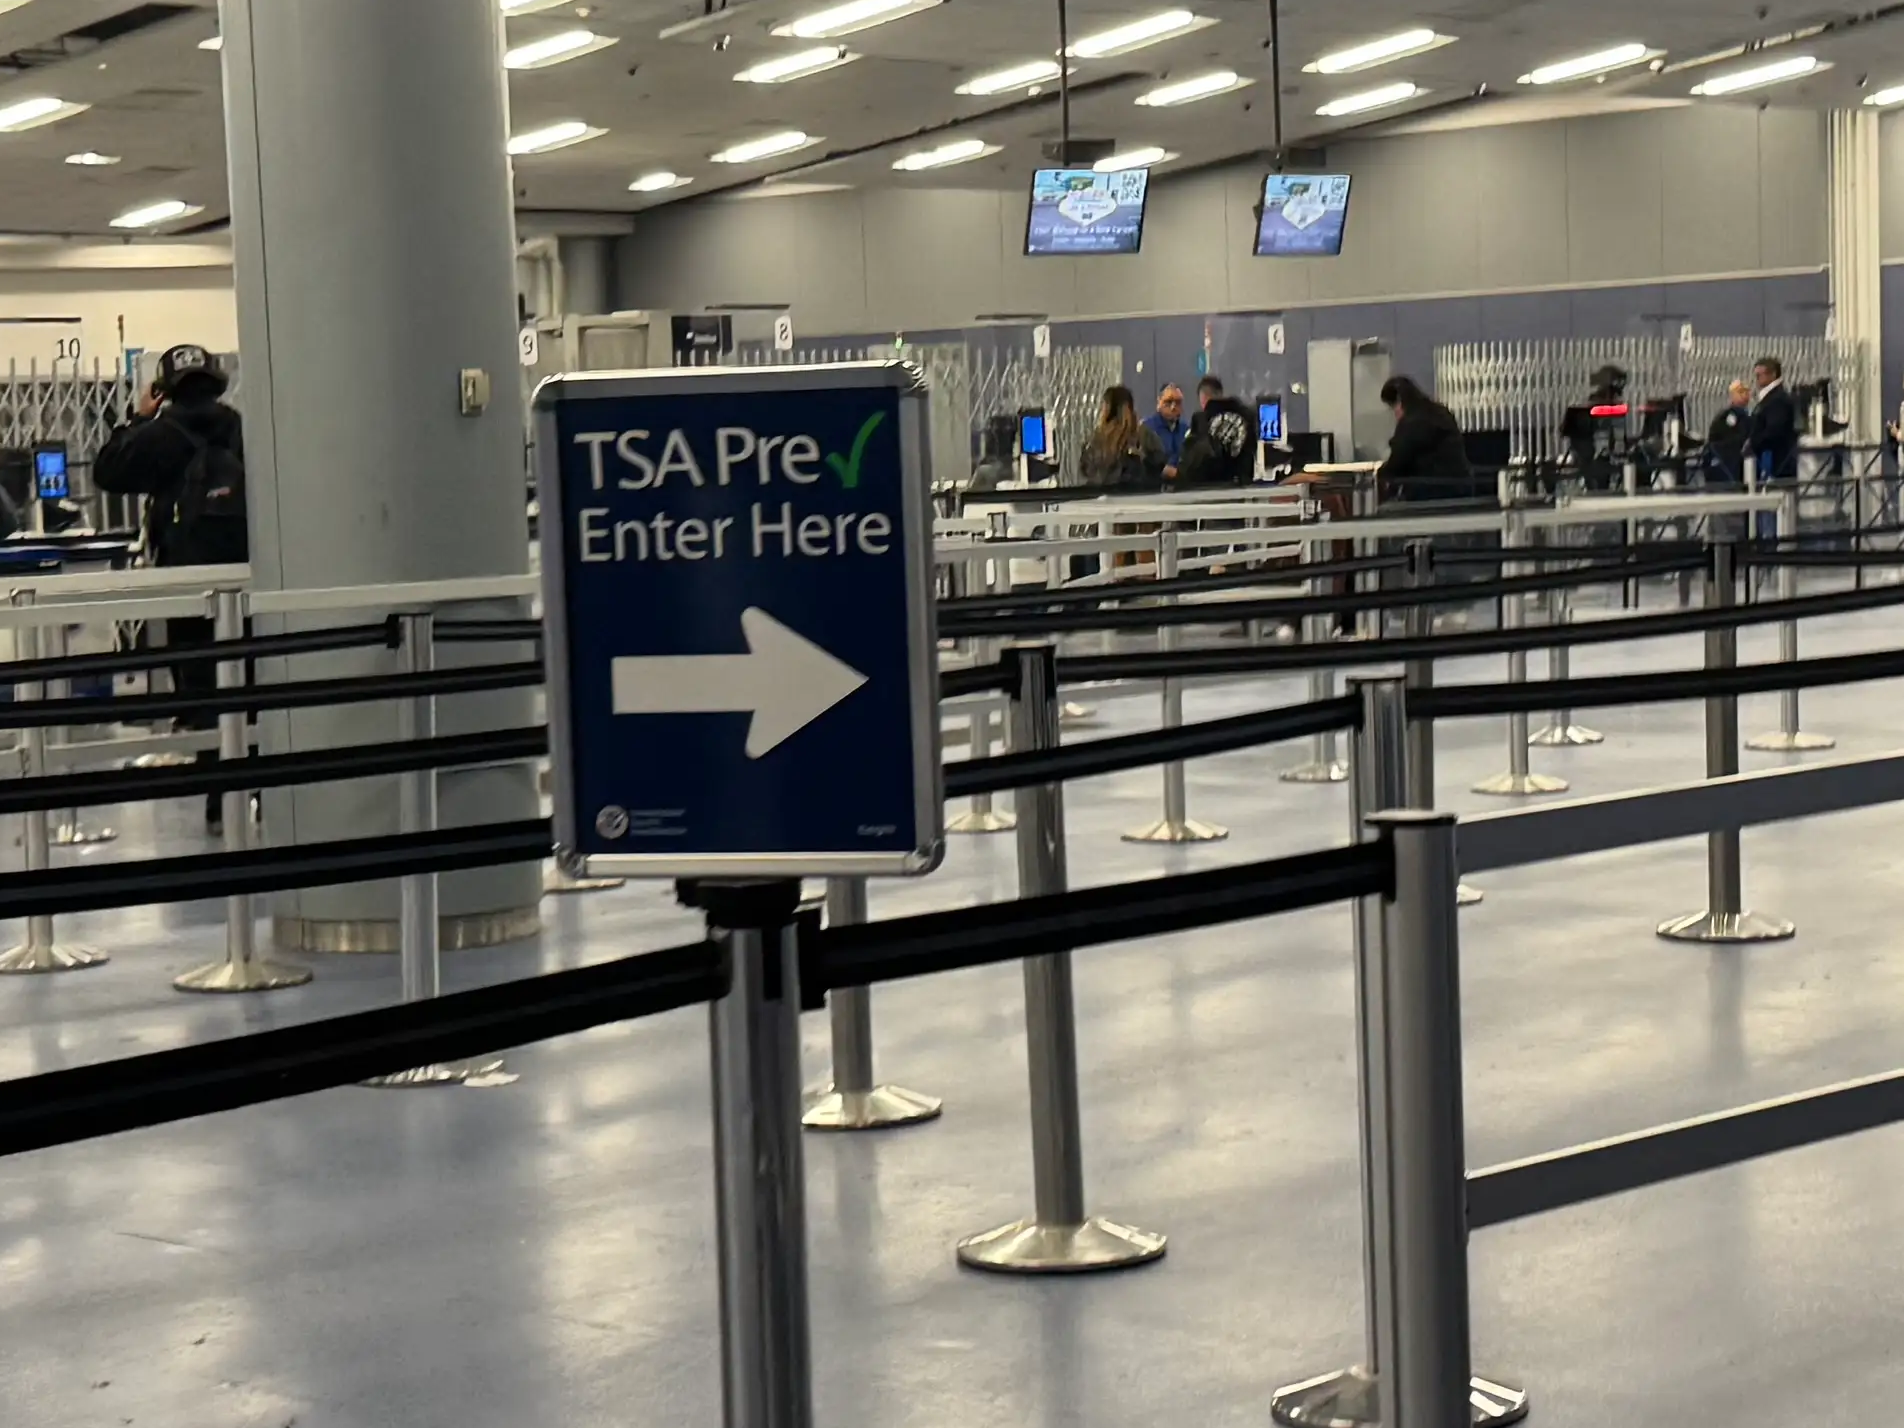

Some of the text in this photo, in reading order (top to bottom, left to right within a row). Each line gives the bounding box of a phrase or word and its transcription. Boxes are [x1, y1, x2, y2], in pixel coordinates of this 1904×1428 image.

[779, 323, 788, 341] 8
[56, 337, 81, 361] 10
[522, 334, 533, 355] 9
[573, 427, 823, 490] TSA Pre
[578, 501, 892, 563] Enter Here
